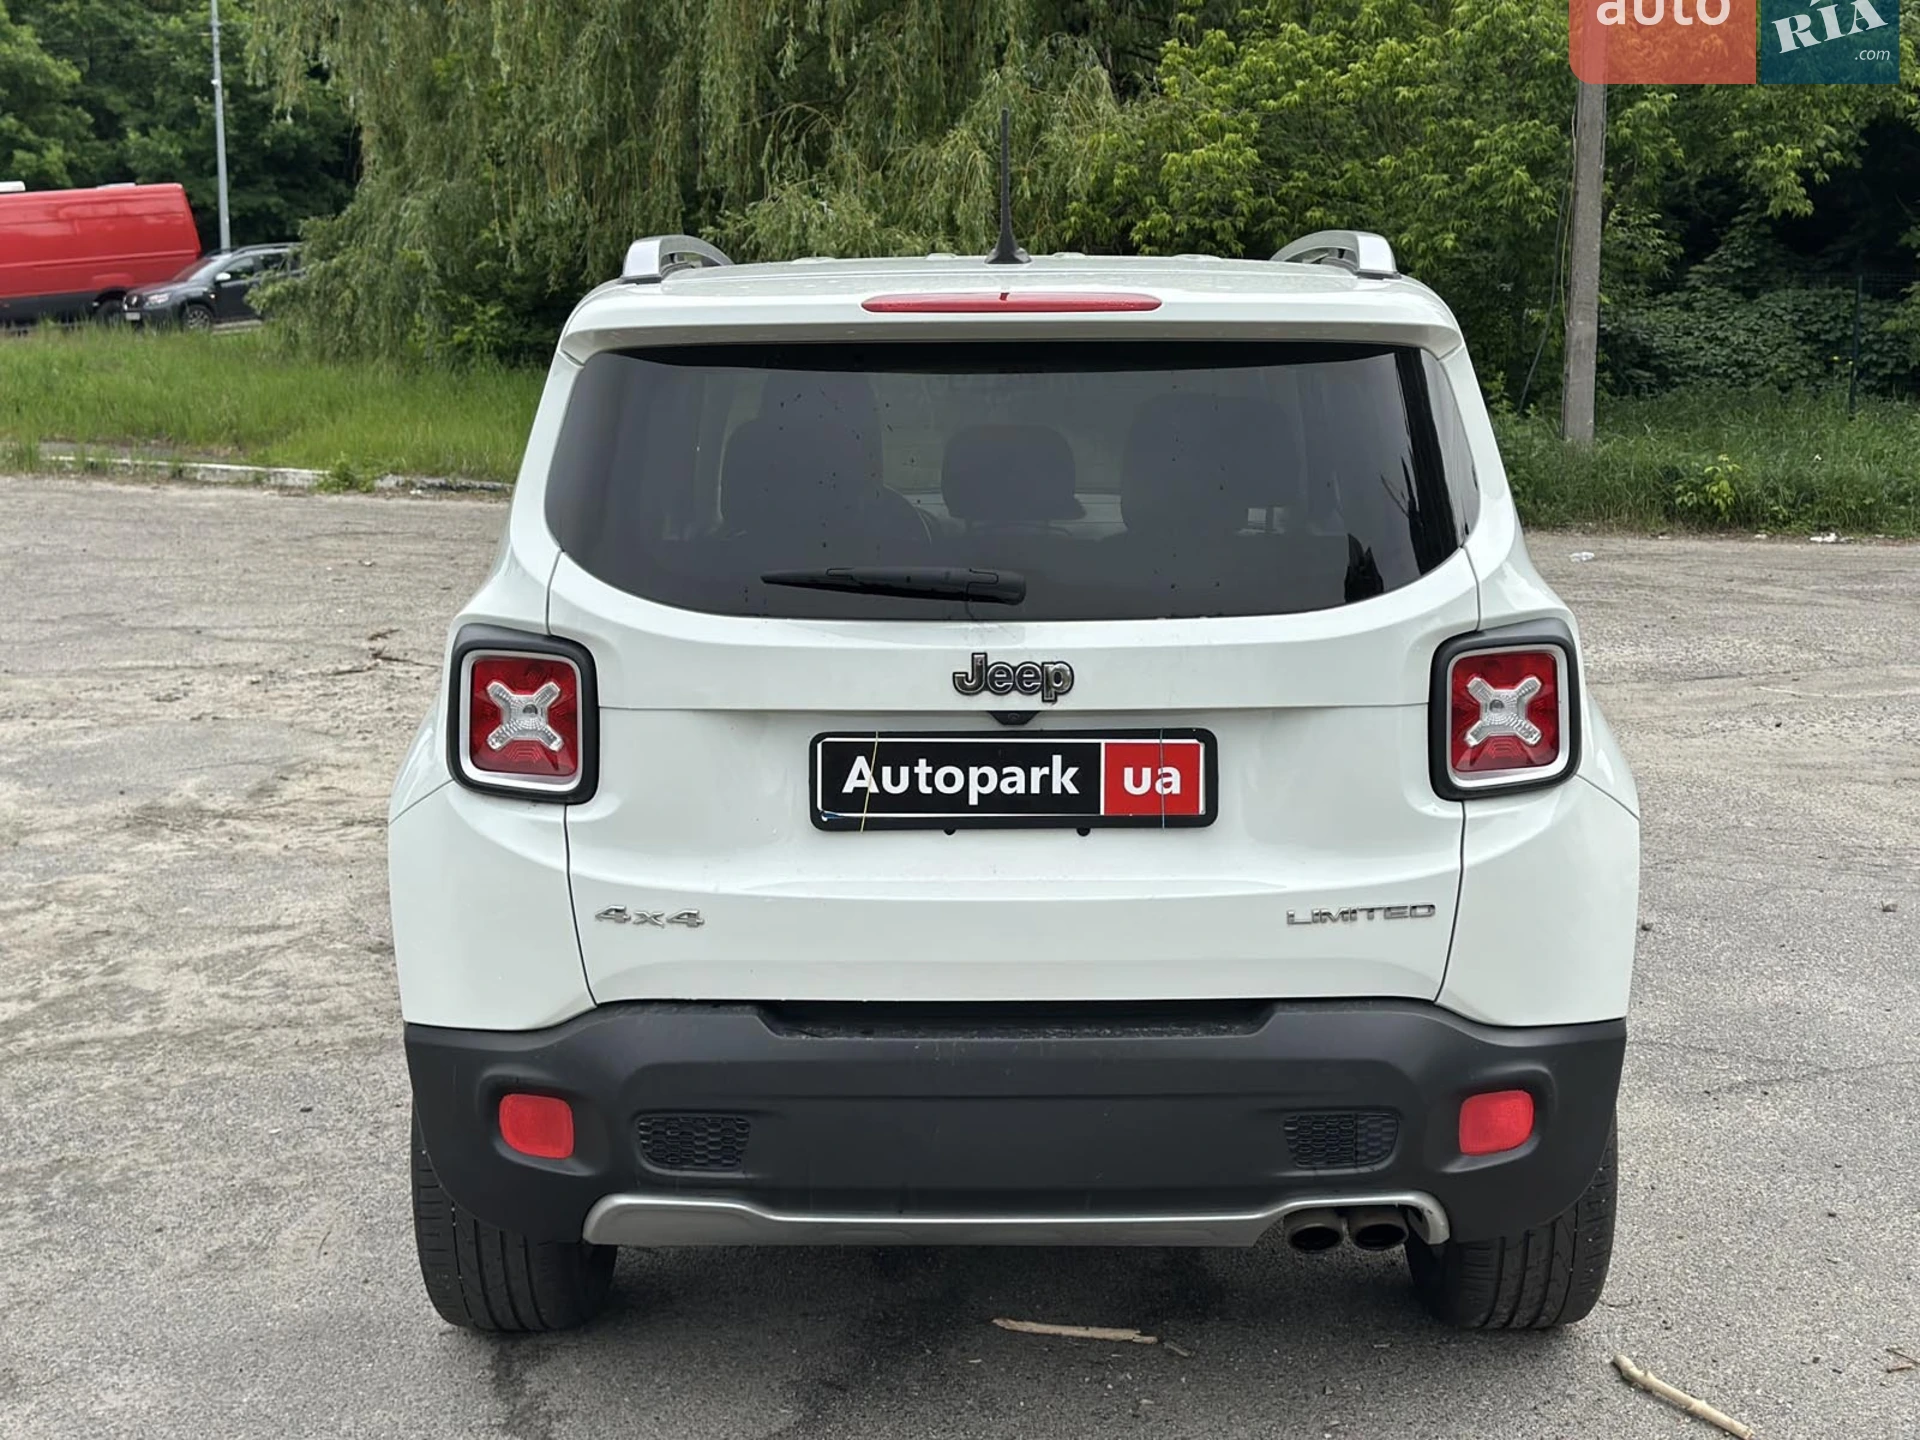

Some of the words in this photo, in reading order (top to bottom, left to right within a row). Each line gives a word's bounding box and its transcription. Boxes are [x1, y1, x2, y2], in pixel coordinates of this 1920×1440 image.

[953, 652, 1075, 703] Jeep
[842, 755, 1080, 806] Autopark
[1122, 765, 1182, 795] ua
[1286, 904, 1437, 926] LIMITED
